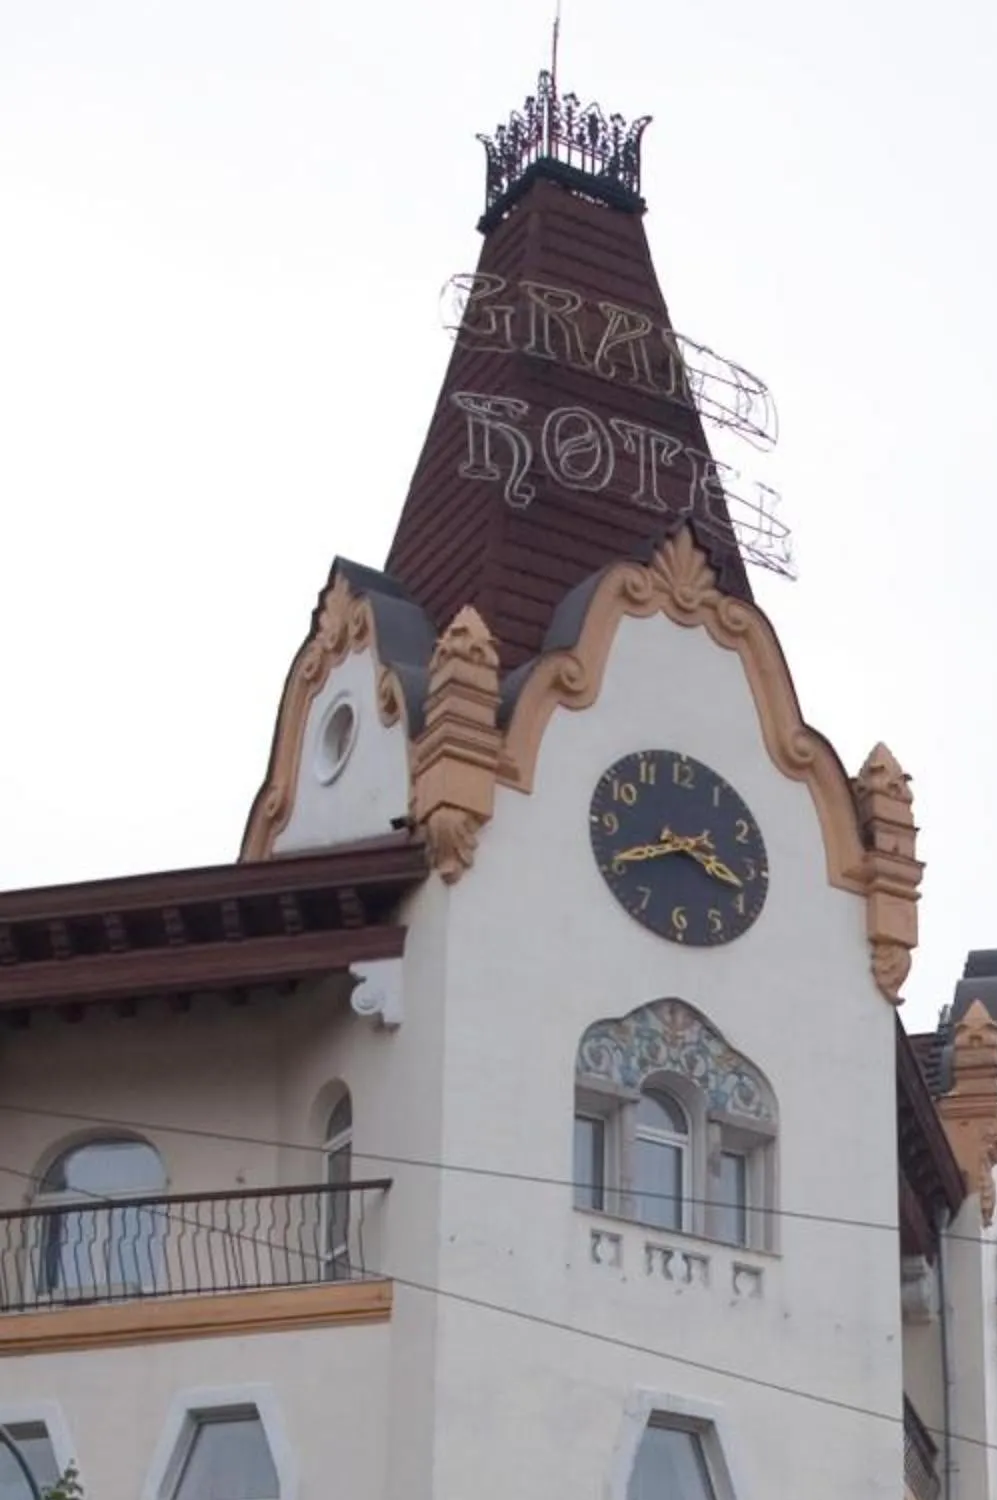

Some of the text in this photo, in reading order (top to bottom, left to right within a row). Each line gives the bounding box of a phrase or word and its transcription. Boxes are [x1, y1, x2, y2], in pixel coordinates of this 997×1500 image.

[639, 760, 657, 785] 11
[672, 761, 696, 789] 12
[612, 779, 638, 807] 10
[712, 785, 720, 807] 1
[602, 813, 620, 836] 9
[735, 819, 750, 844] 2
[742, 857, 756, 881] 3
[636, 884, 652, 911] 7
[731, 892, 746, 915] 4
[671, 906, 688, 930] 6
[707, 908, 723, 933] 5
